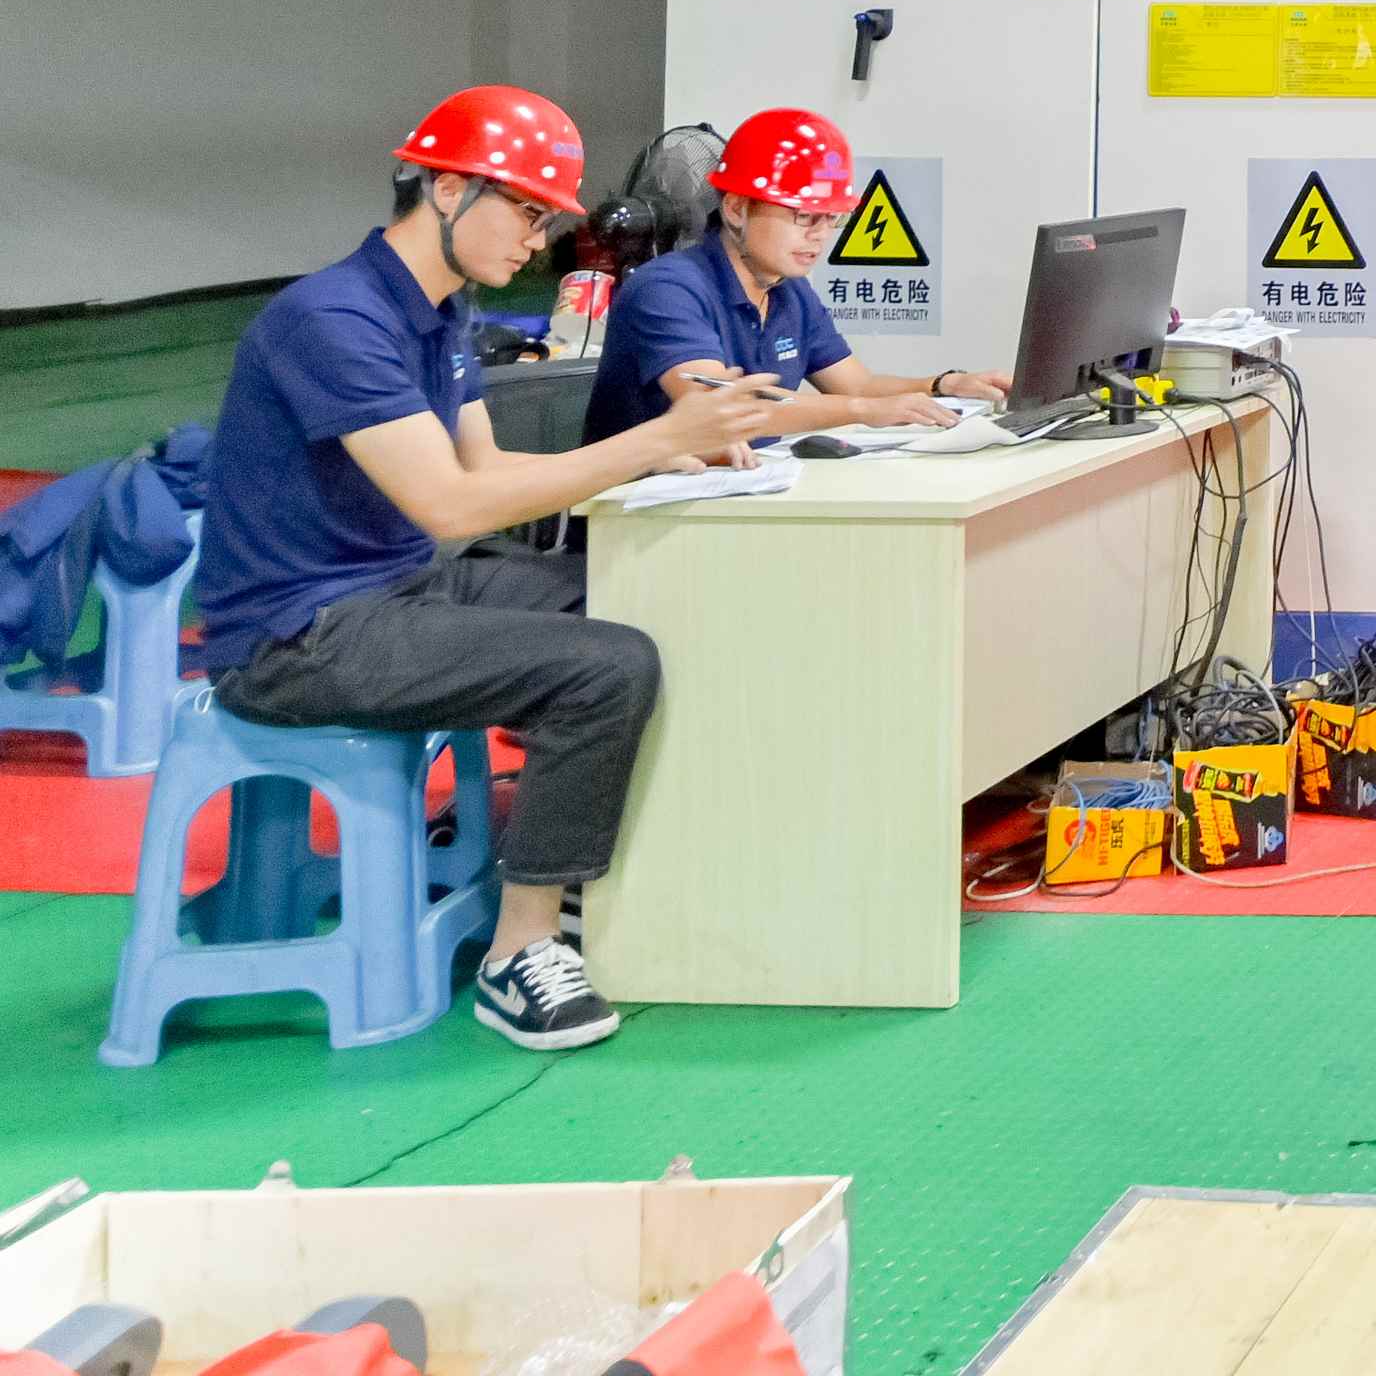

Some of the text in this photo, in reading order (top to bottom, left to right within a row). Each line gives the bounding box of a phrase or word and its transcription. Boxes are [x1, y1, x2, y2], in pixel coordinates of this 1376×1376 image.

[828, 278, 930, 304] 有电危险
[1262, 280, 1366, 307] 有电危险
[832, 307, 928, 321] ANGER WITH ELECTRICITY
[1297, 311, 1315, 323] WITH
[1320, 311, 1366, 324] ELECTRICITY
